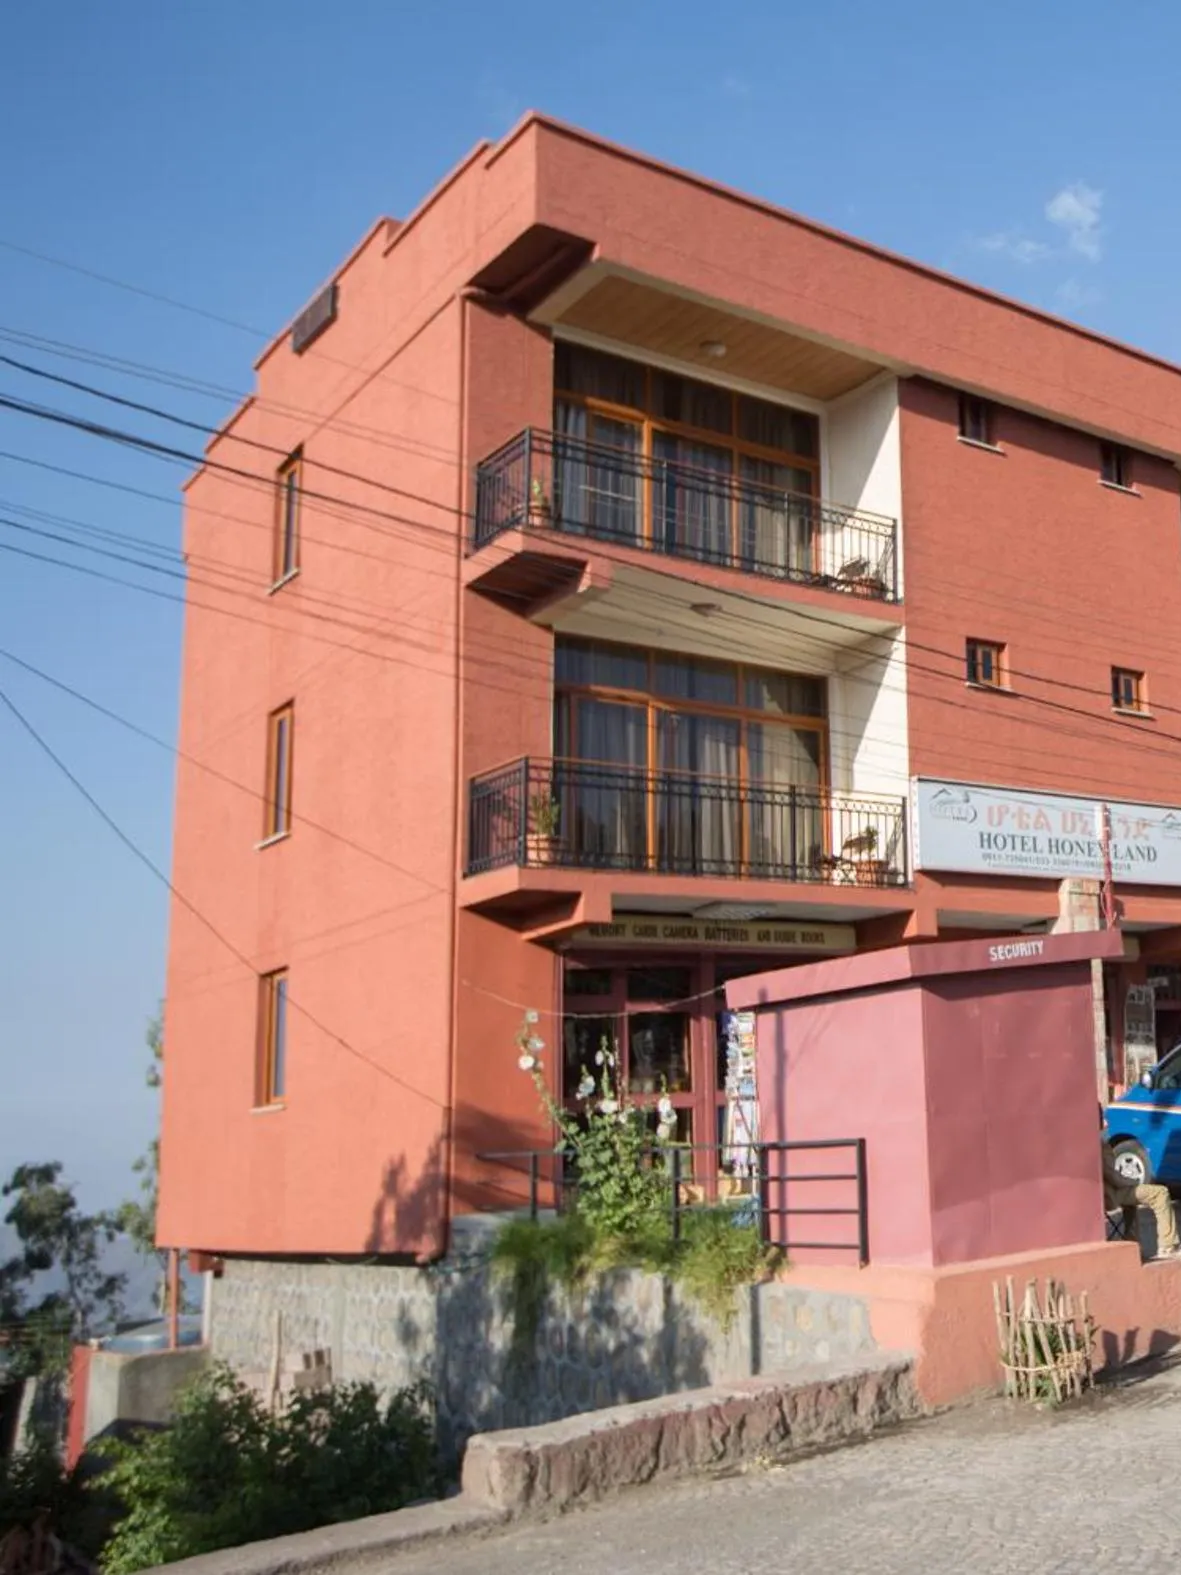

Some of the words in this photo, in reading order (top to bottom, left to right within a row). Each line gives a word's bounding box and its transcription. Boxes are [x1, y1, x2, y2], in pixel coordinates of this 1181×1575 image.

[979, 831, 1044, 854] HOTEL
[1113, 843, 1158, 863] LAND
[662, 925, 700, 940] CAMERA
[704, 926, 749, 943] BATTERIES
[988, 939, 1044, 962] SECURITY
